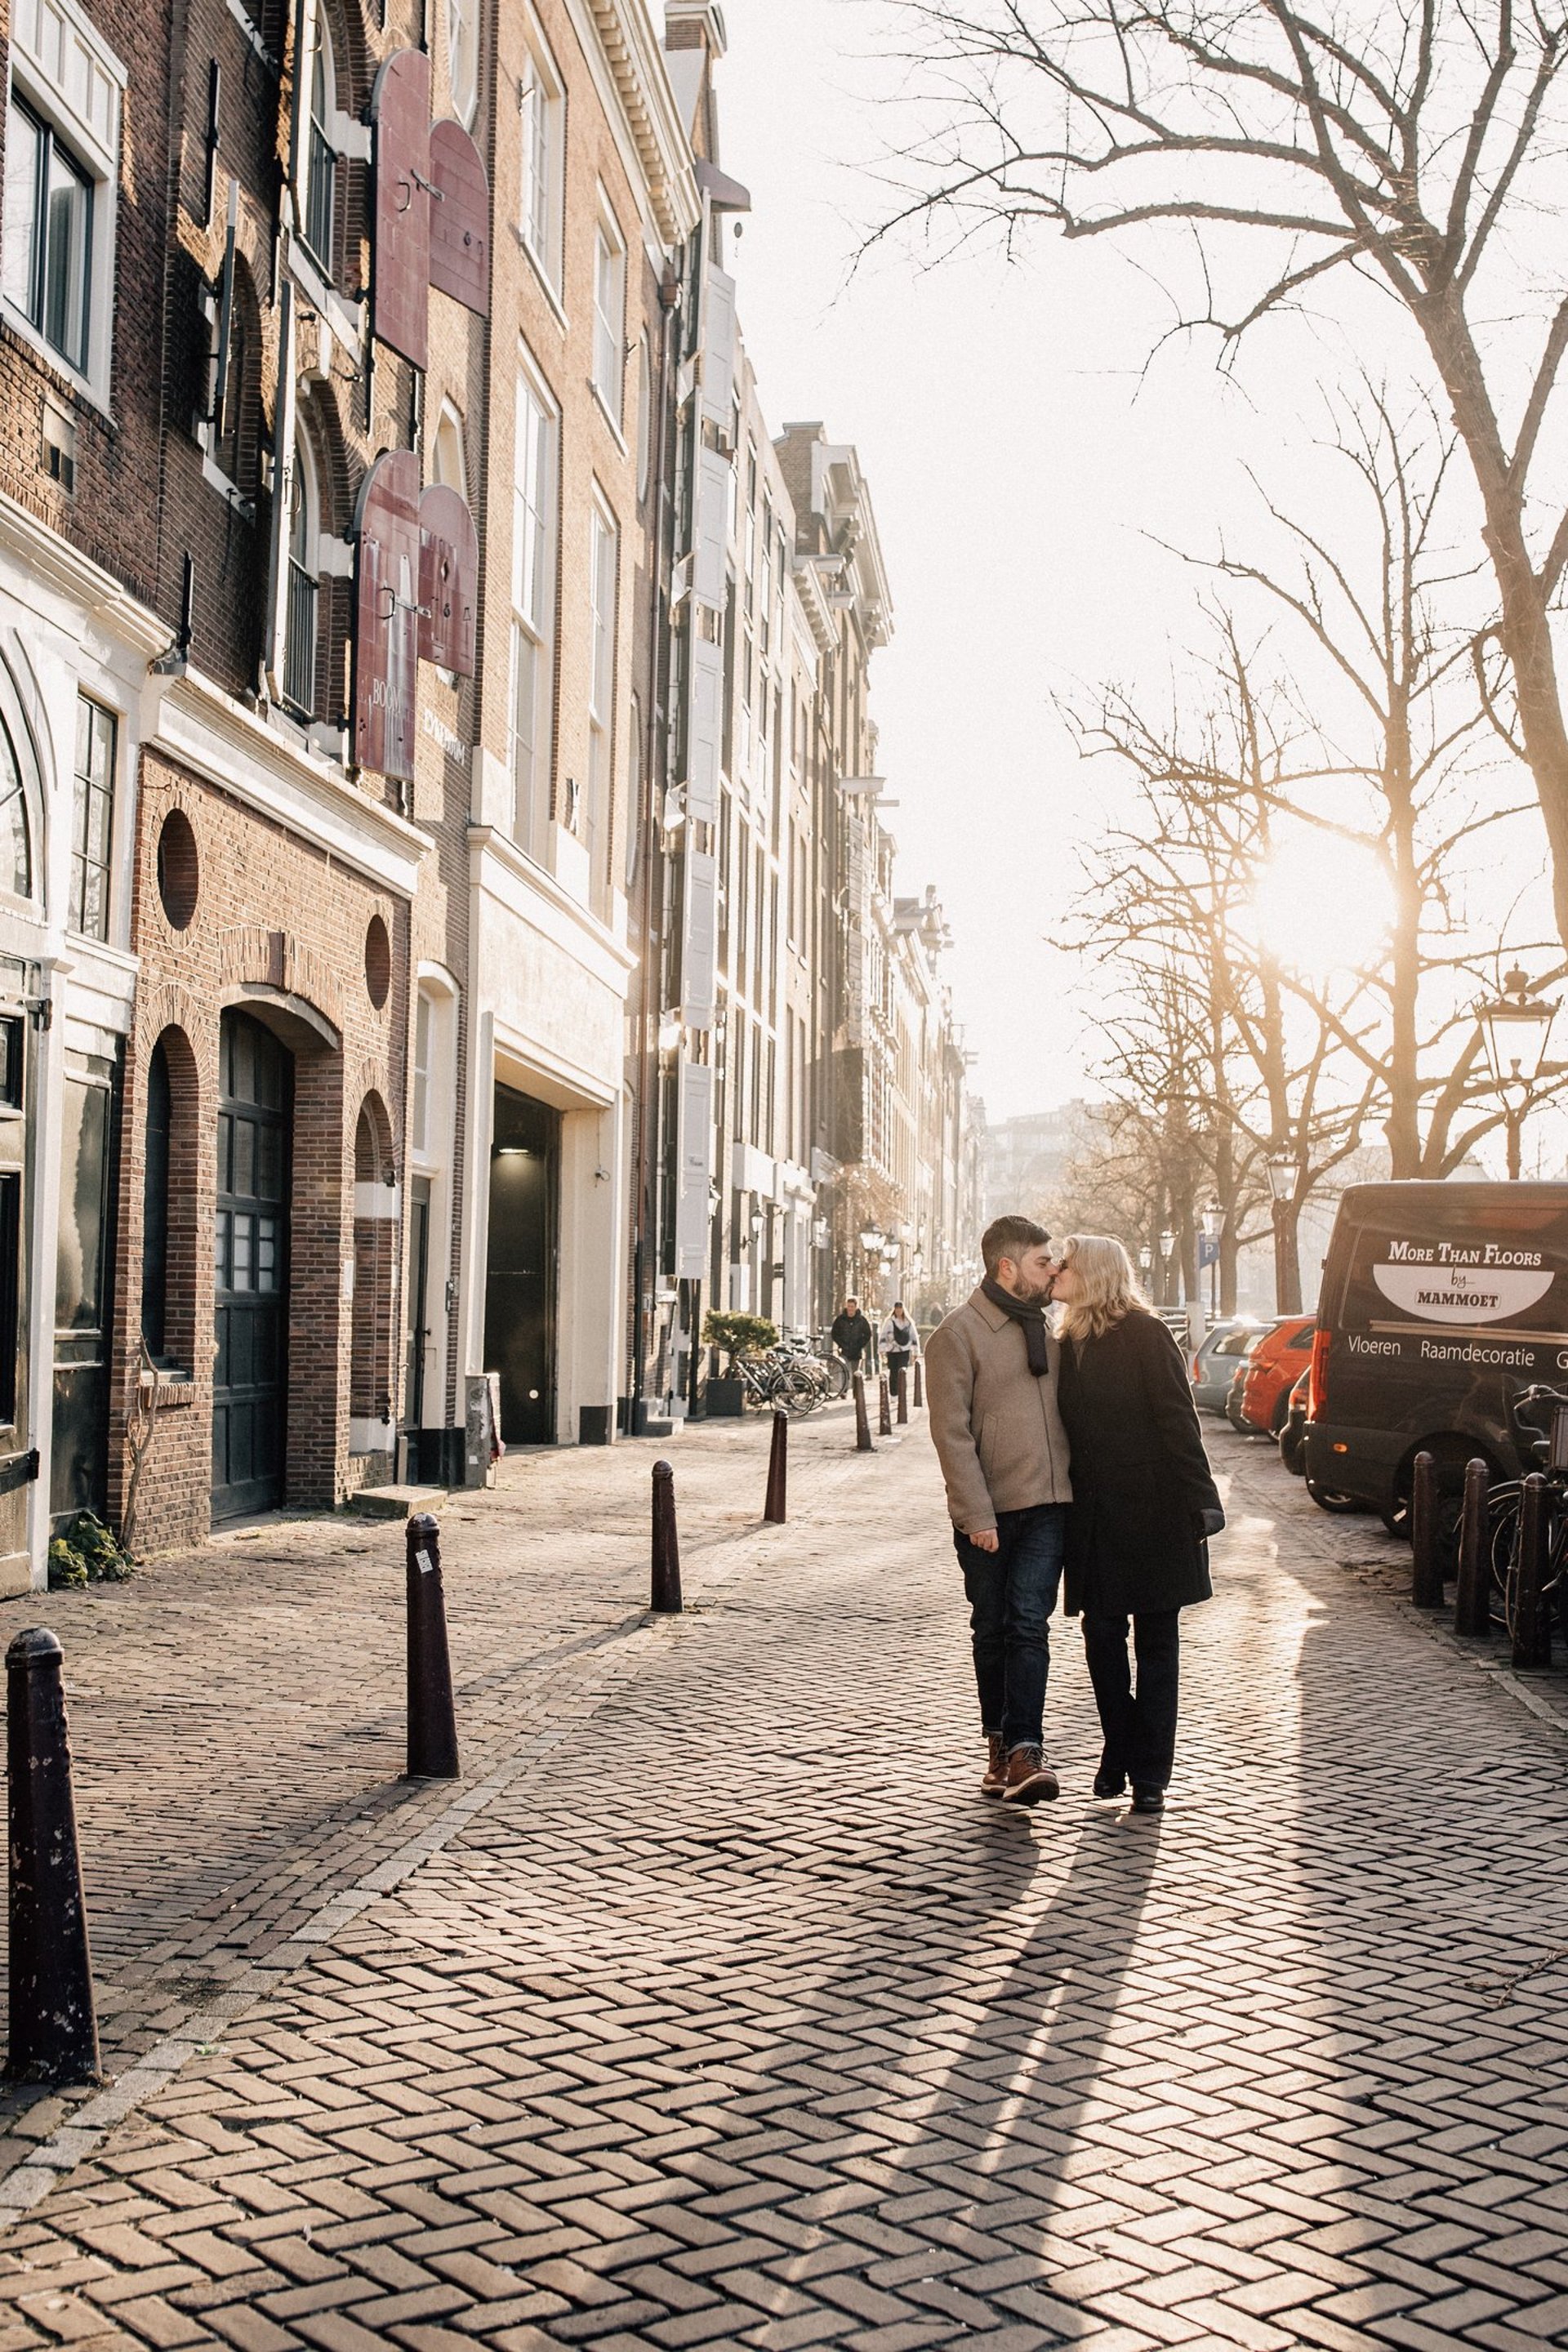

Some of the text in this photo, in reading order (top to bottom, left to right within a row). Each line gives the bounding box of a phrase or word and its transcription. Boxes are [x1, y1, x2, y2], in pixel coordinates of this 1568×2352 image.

[1205, 1244, 1214, 1258] P
[1451, 1265, 1475, 1289] by
[1417, 1291, 1499, 1307] MAMMOET
[1348, 1334, 1401, 1356] Vloeren
[1420, 1340, 1535, 1367] Raamdecoratie
